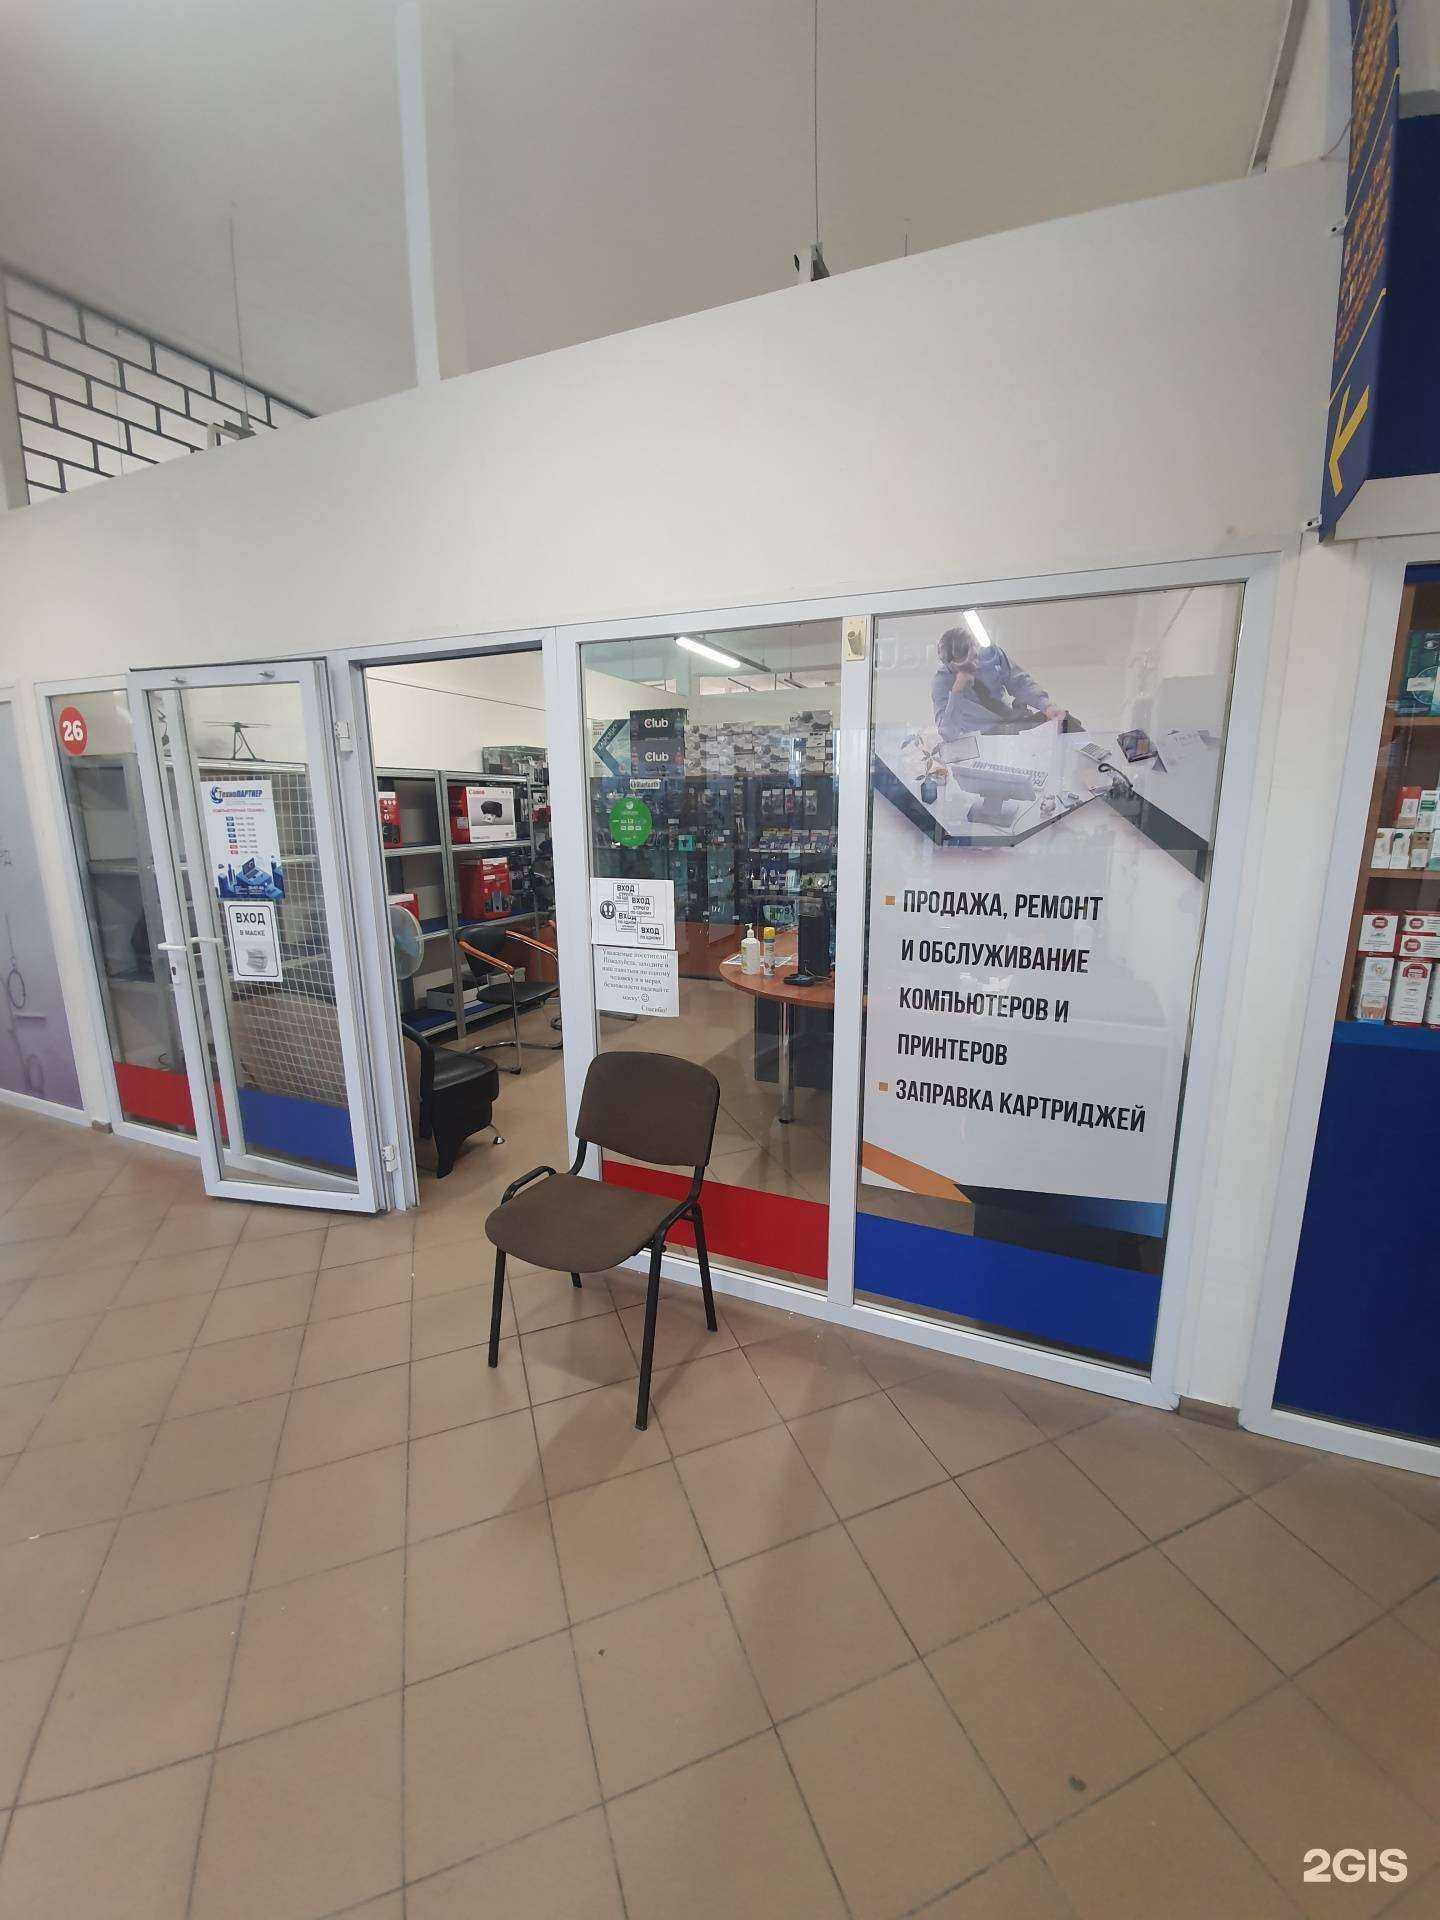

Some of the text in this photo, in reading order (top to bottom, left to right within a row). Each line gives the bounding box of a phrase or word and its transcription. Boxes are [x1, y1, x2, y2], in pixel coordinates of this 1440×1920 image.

[62, 719, 84, 742] 26
[644, 718, 669, 729] Club
[645, 751, 670, 762] Club
[616, 884, 635, 892] ВХОД
[631, 897, 651, 905] ВХОД
[902, 888, 1104, 922] ПРОДАЖА, РЕМОНТ
[235, 912, 266, 925] ВХОД
[640, 926, 660, 935] ВХОД
[900, 938, 1091, 975] И ОБСЛУЖИВАНИЕ
[898, 986, 1070, 1024] КОМПЬЮТЕРОВ И
[896, 1032, 1009, 1066] ПРИНТЕРОВ
[894, 1078, 1147, 1134] ЗАПРАВКА КАРТРИДЖЕЙ
